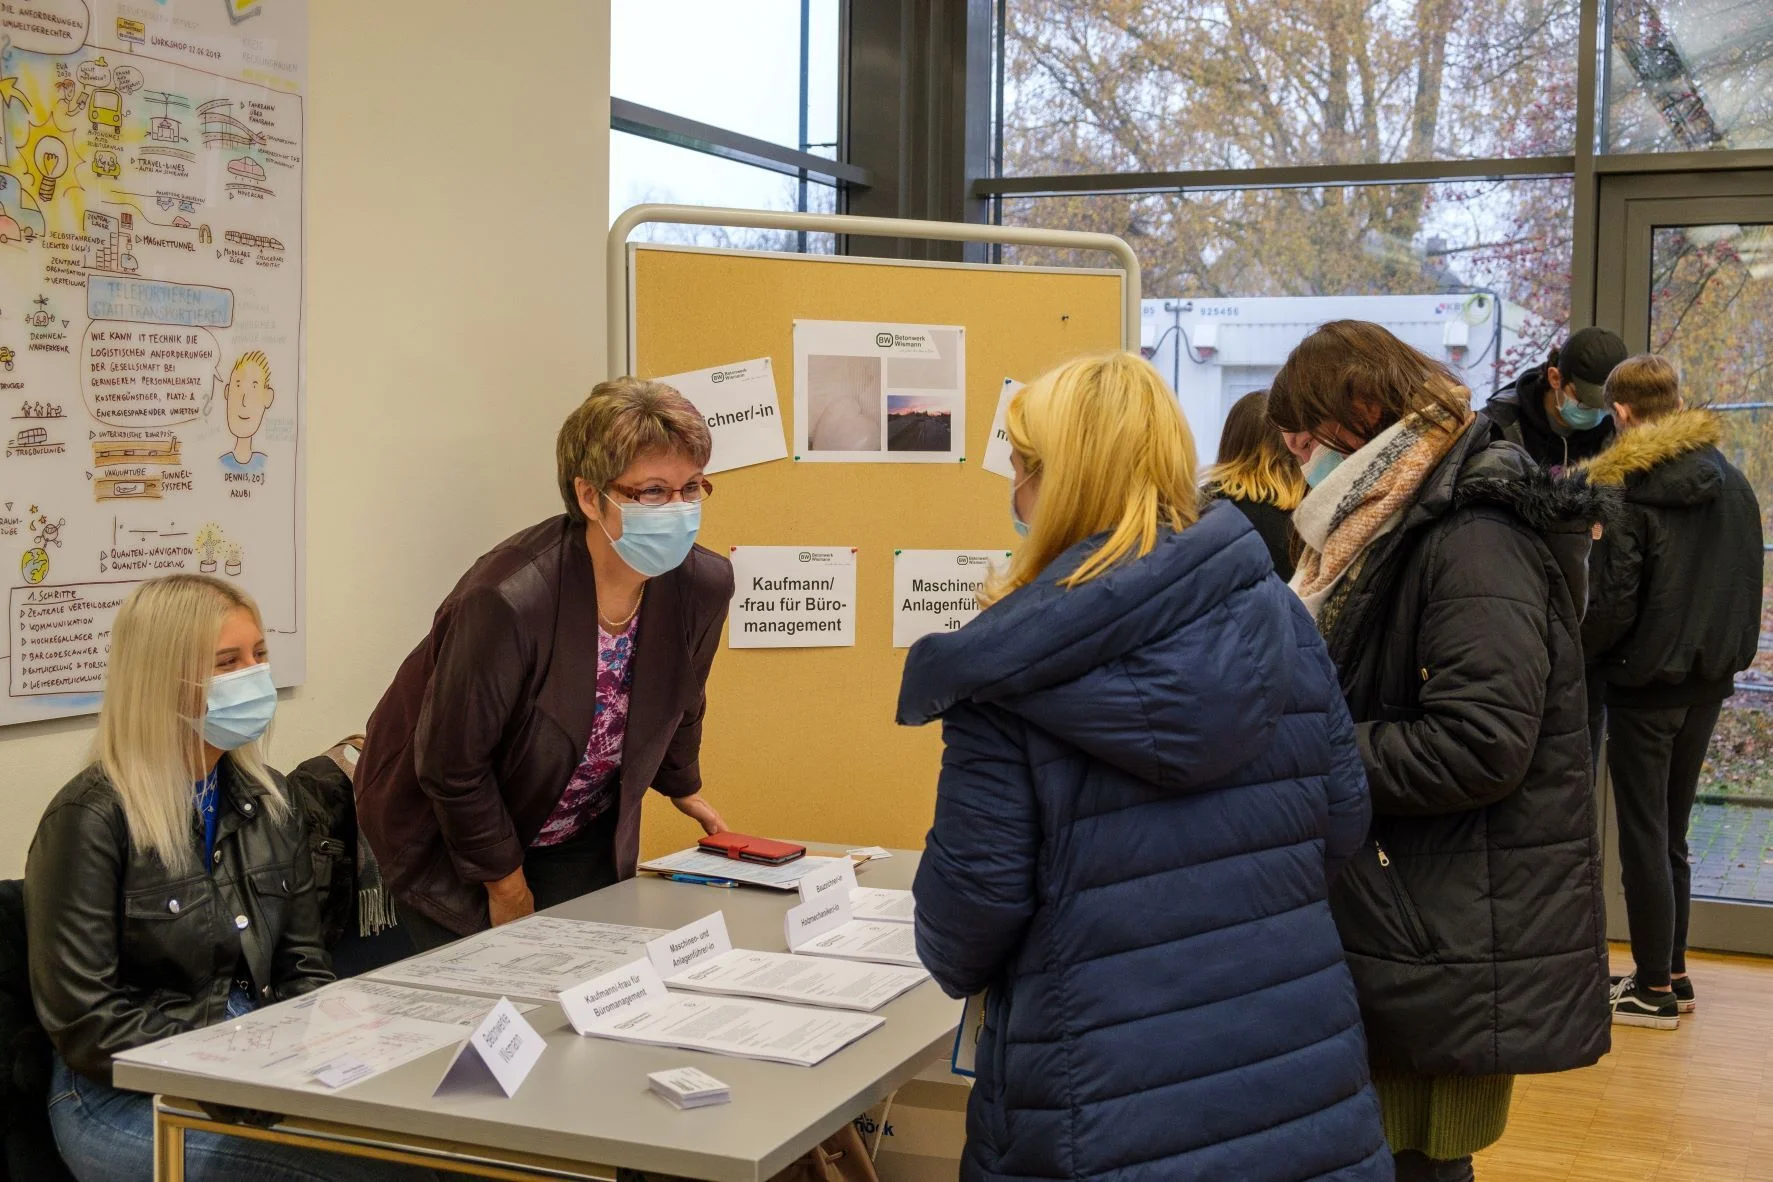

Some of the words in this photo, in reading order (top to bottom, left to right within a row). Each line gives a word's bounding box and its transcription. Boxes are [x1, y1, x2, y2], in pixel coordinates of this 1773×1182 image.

[1, 3, 14, 14] DIE
[20, 8, 83, 29] ANFORDERUNGEN
[3, 20, 72, 40] UMWELTGERECHTER
[151, 35, 187, 50] WORKSHOP
[237, 190, 264, 200] HOVERCAR
[91, 220, 110, 230] LAGER
[42, 240, 69, 250] ELEKTRO
[143, 235, 196, 252] MAGNETTUNNEL
[51, 256, 80, 267] ZENTRALE
[46, 265, 86, 277] ORGANISATION
[51, 276, 86, 288] VERTEILUNG
[107, 282, 202, 303] TELEPORTIEREN
[91, 332, 107, 341] WIE
[109, 332, 132, 341] KANN
[138, 333, 147, 341] IT
[148, 334, 182, 344] TECHNIK
[186, 335, 198, 345] DIE
[894, 334, 926, 342] Betonwerk
[894, 340, 922, 348] Wismann
[91, 347, 146, 358] LOGISTISCHEN
[150, 349, 213, 360] ANFORDERUNGEN
[91, 362, 106, 373] DER
[110, 362, 161, 373] GESELLSCHAFT
[164, 363, 176, 373] BEI
[91, 378, 137, 387] GERINGEREM
[141, 376, 202, 387] PERSONALEINSATZ
[95, 391, 162, 403] KOSTENGÜNSTIGER,
[166, 392, 188, 401] PLATZ-
[96, 408, 166, 419] ENERGIESPARENDER
[169, 407, 200, 416] UMSETZEN
[703, 403, 774, 428] chner/-in
[98, 430, 143, 440] UNTERIRDISCHE
[104, 467, 147, 478] VAKUUMTUBE
[161, 470, 193, 480] TUNNEL-
[224, 473, 250, 484] DENNIS,
[161, 482, 193, 492] SYSTEME
[230, 489, 251, 499] AZUBI
[752, 576, 835, 591] Kaufmann/
[39, 590, 77, 602] SCHRITTE
[739, 597, 775, 612] -frau
[780, 597, 801, 611] für
[805, 597, 847, 611] Büro-
[902, 598, 979, 614] Anlagenfüh
[27, 605, 65, 618] ZENTRALE
[29, 617, 94, 632] KOMMUNIKATION
[744, 618, 842, 636] management
[944, 617, 961, 630] -in
[30, 633, 93, 646] HOCHREGALLAGER
[98, 631, 110, 640] MIT
[29, 647, 99, 662] BARCODESCANNER
[28, 663, 73, 675] ENTWICKLUNG
[30, 674, 102, 690] WEITERENTWICKLUNG
[593, 988, 647, 1017] Büromanagement
